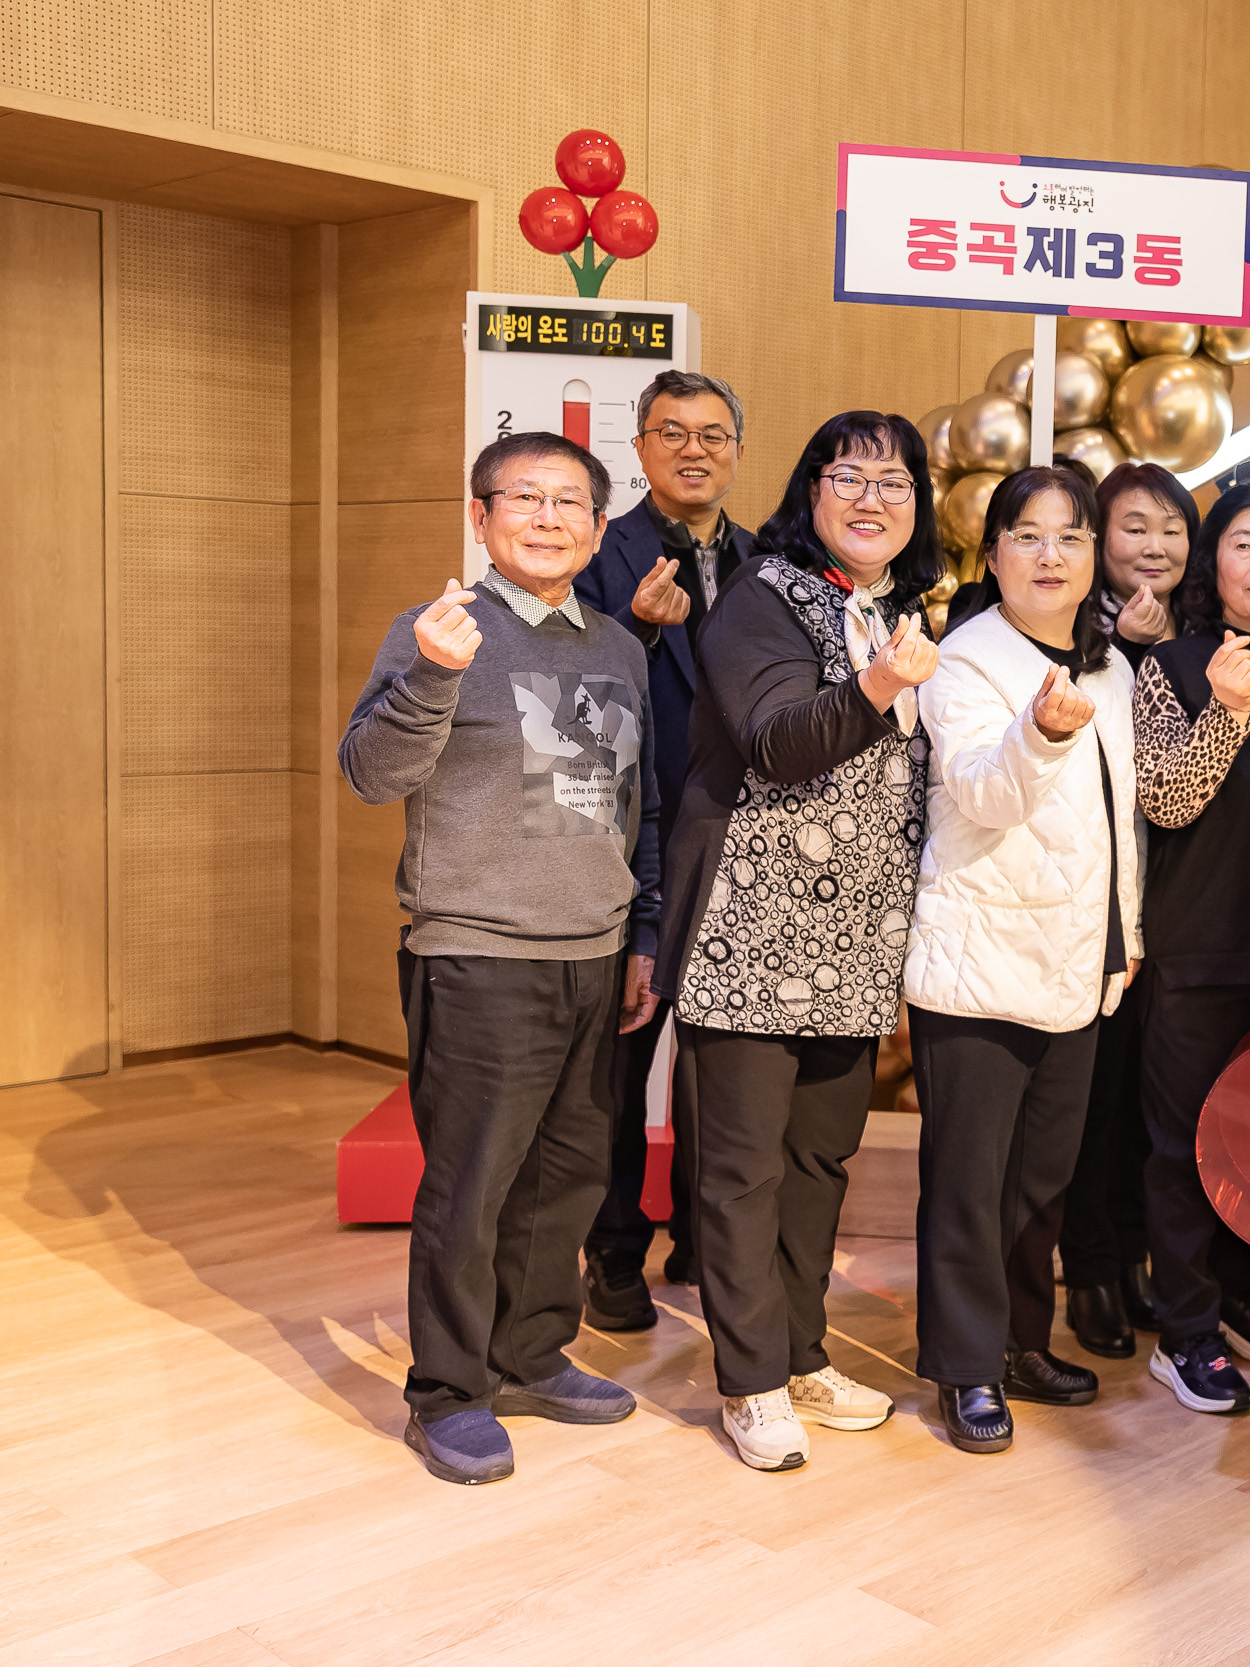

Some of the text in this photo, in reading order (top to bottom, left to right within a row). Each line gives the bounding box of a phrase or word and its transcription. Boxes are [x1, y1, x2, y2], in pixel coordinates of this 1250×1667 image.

[1042, 194, 1094, 213] 행복광진
[906, 217, 1184, 287] 중곡제3동
[486, 313, 532, 343] 사랑의
[537, 315, 568, 344] 온도
[630, 477, 647, 489] 80
[557, 732, 612, 743] KANGOL
[567, 761, 586, 769] Born
[579, 772, 592, 781] but
[593, 772, 615, 781] raised
[572, 786, 586, 795] the
[587, 786, 611, 795] streets
[568, 800, 586, 808] New
[587, 800, 604, 808] York
